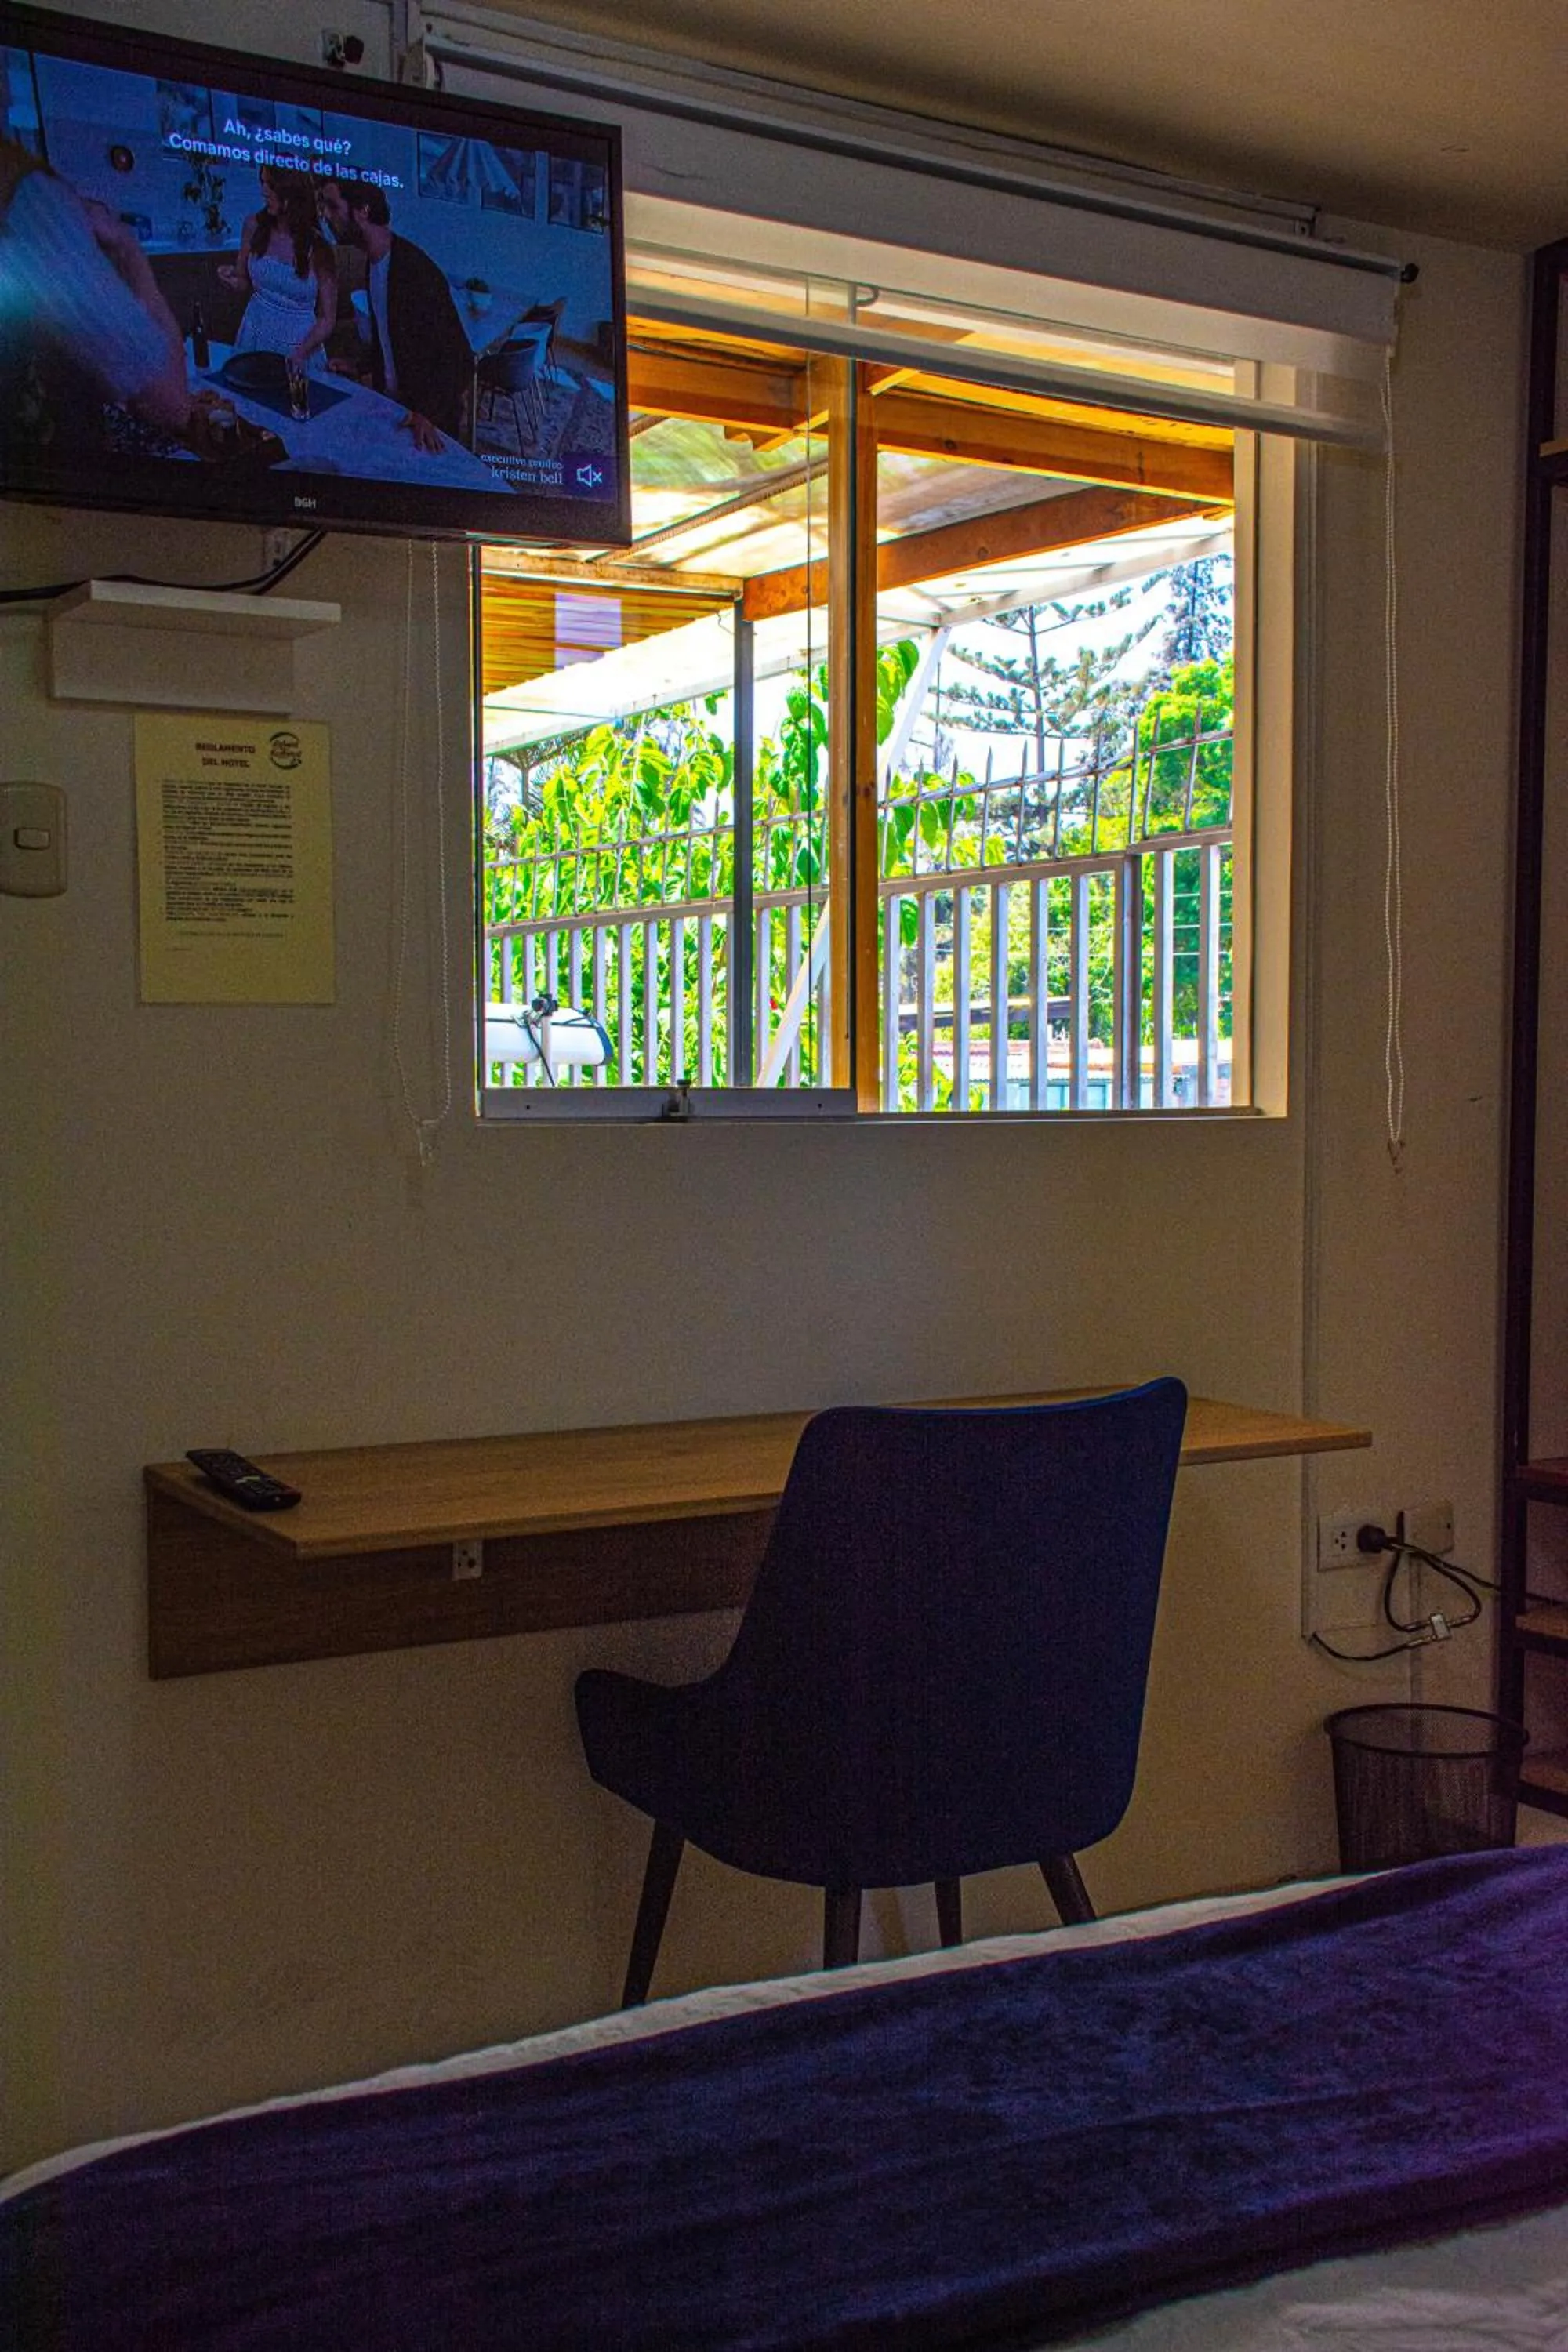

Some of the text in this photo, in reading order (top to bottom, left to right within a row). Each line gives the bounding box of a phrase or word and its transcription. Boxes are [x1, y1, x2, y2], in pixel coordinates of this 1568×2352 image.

[223, 118, 352, 156] Ah, ¿sabes qué?
[169, 132, 405, 189] Comamos directo de las cajas.
[492, 465, 563, 484] kristen bell
